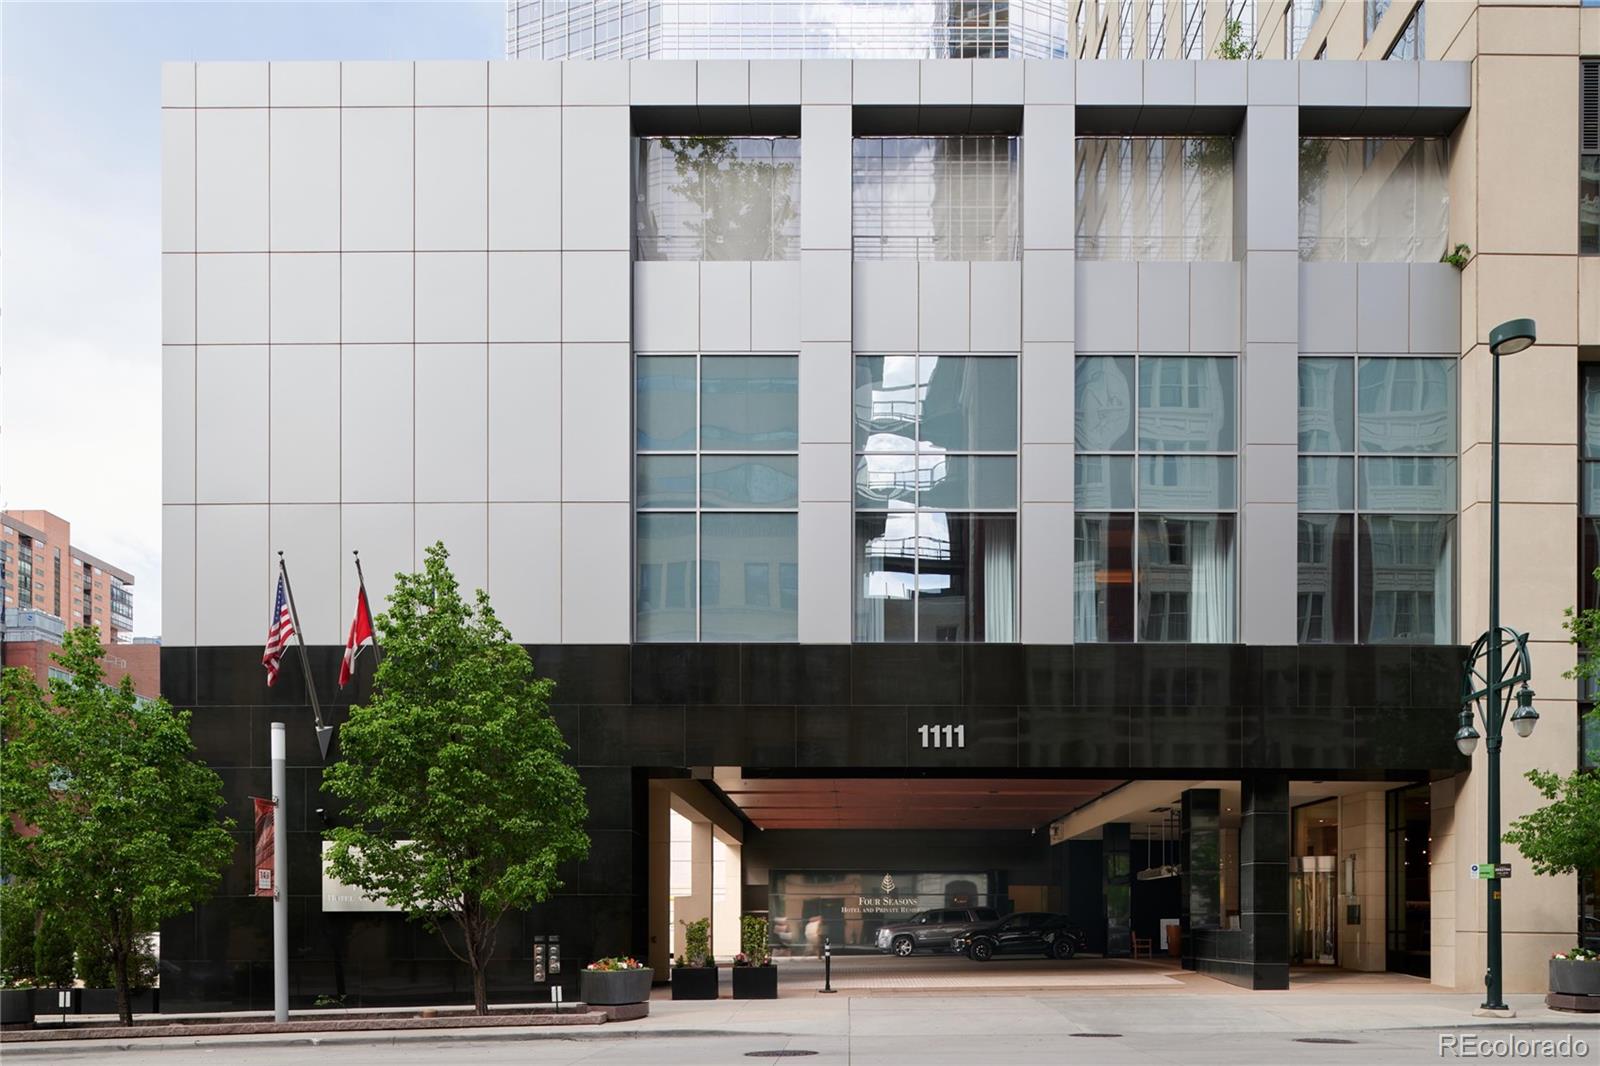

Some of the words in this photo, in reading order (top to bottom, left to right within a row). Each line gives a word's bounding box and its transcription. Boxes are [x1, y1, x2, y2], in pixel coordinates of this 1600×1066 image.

[918, 724, 965, 748] 1111
[858, 897, 881, 906] FOUR
[883, 896, 919, 906] SEASONS
